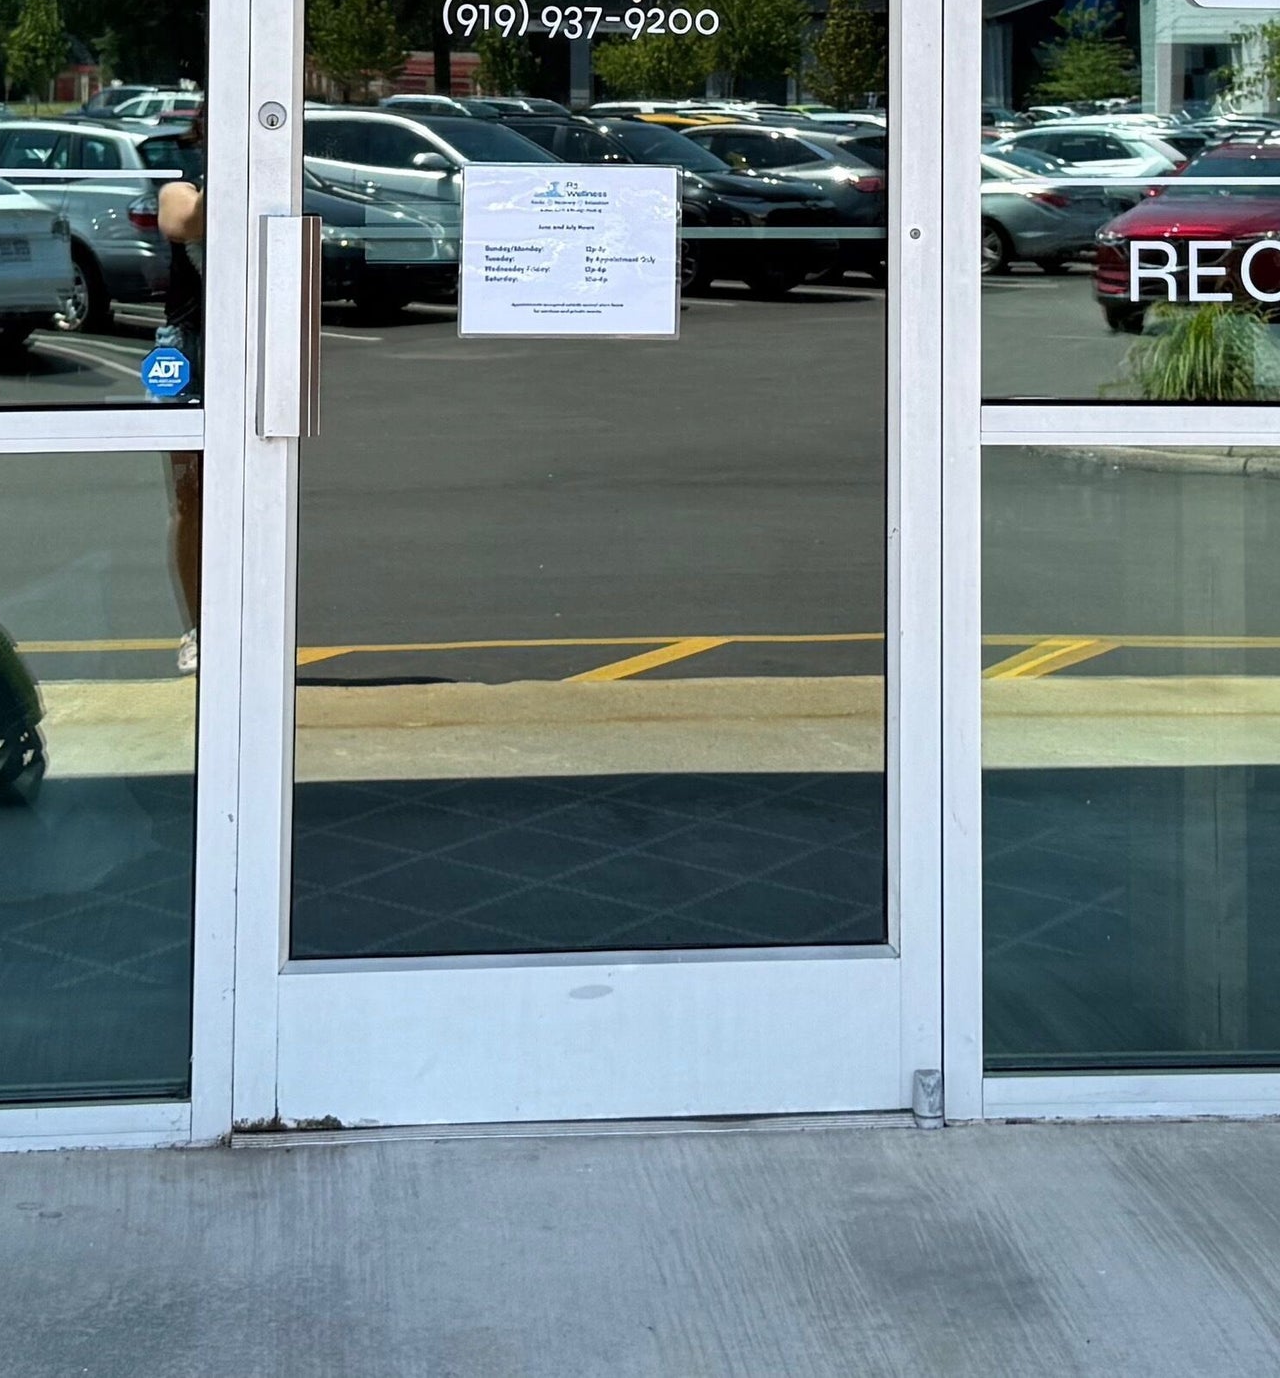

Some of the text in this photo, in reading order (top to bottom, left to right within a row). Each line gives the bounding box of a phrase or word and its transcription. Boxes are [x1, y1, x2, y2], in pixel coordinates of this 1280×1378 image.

[540, 5, 720, 40] 937-9200
[566, 190, 608, 198] Wellness
[148, 361, 184, 379] ADT
